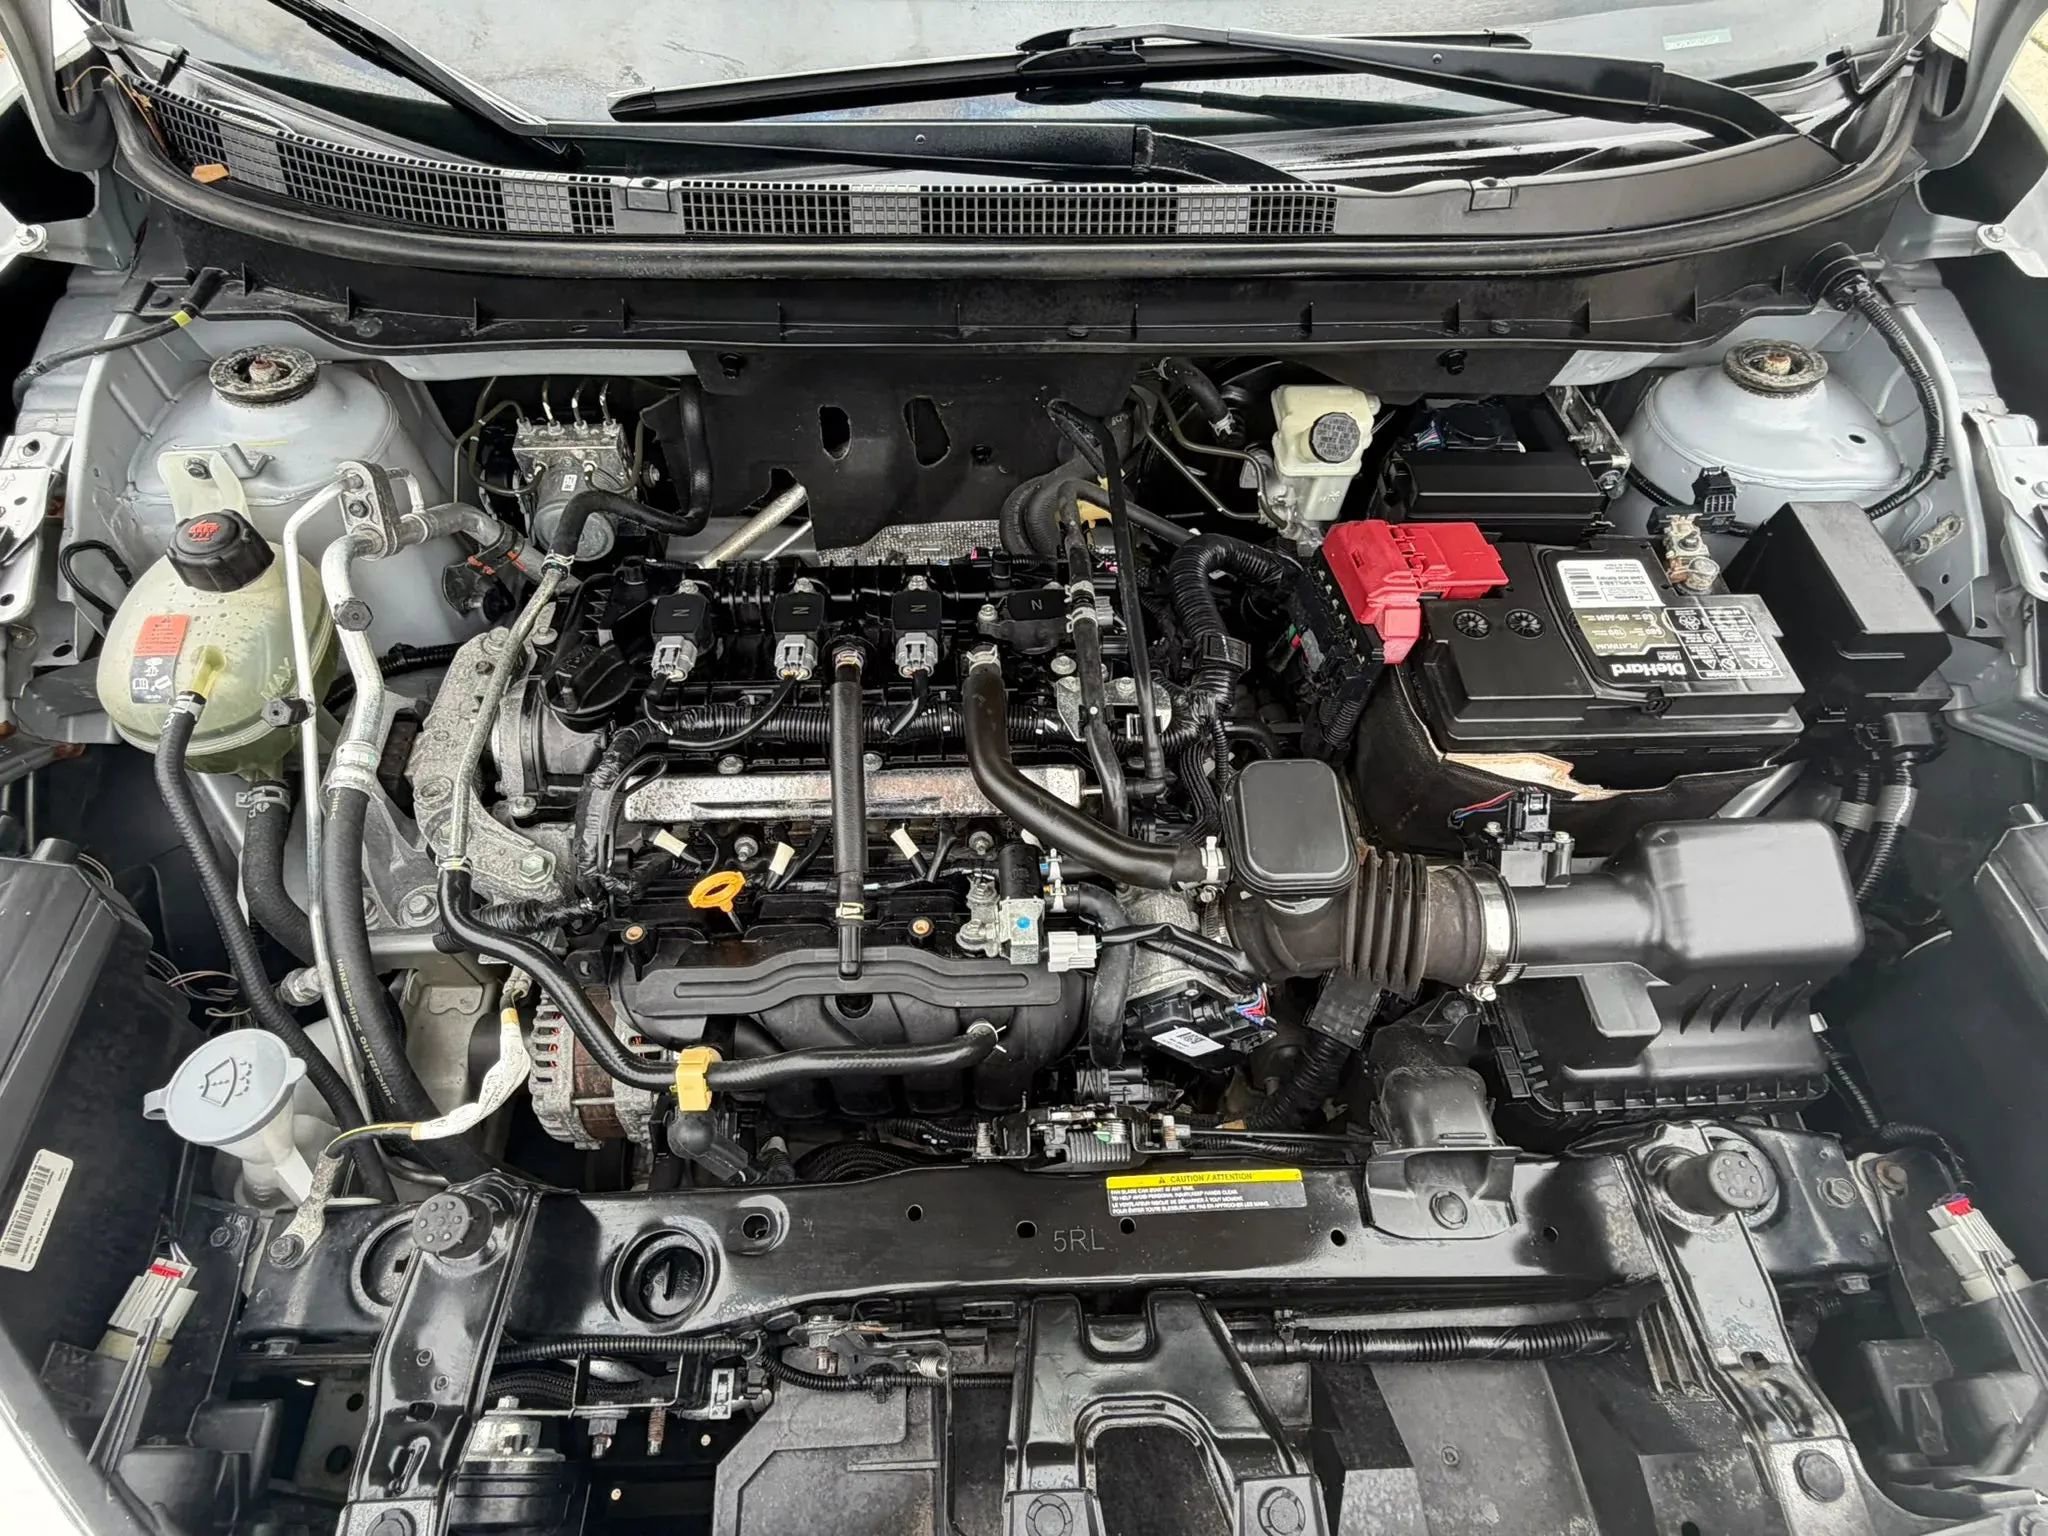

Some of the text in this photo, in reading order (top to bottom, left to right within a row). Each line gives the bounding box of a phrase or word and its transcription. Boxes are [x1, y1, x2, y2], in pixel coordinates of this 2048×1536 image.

[1031, 599, 1043, 611] N
[1595, 642, 1639, 650] PLATINUM
[1611, 662, 1687, 678] DieHard
[1170, 1174, 1204, 1183] CAUTION
[1212, 1173, 1252, 1181] ATTENTION
[1053, 1228, 1105, 1252] 5RL
